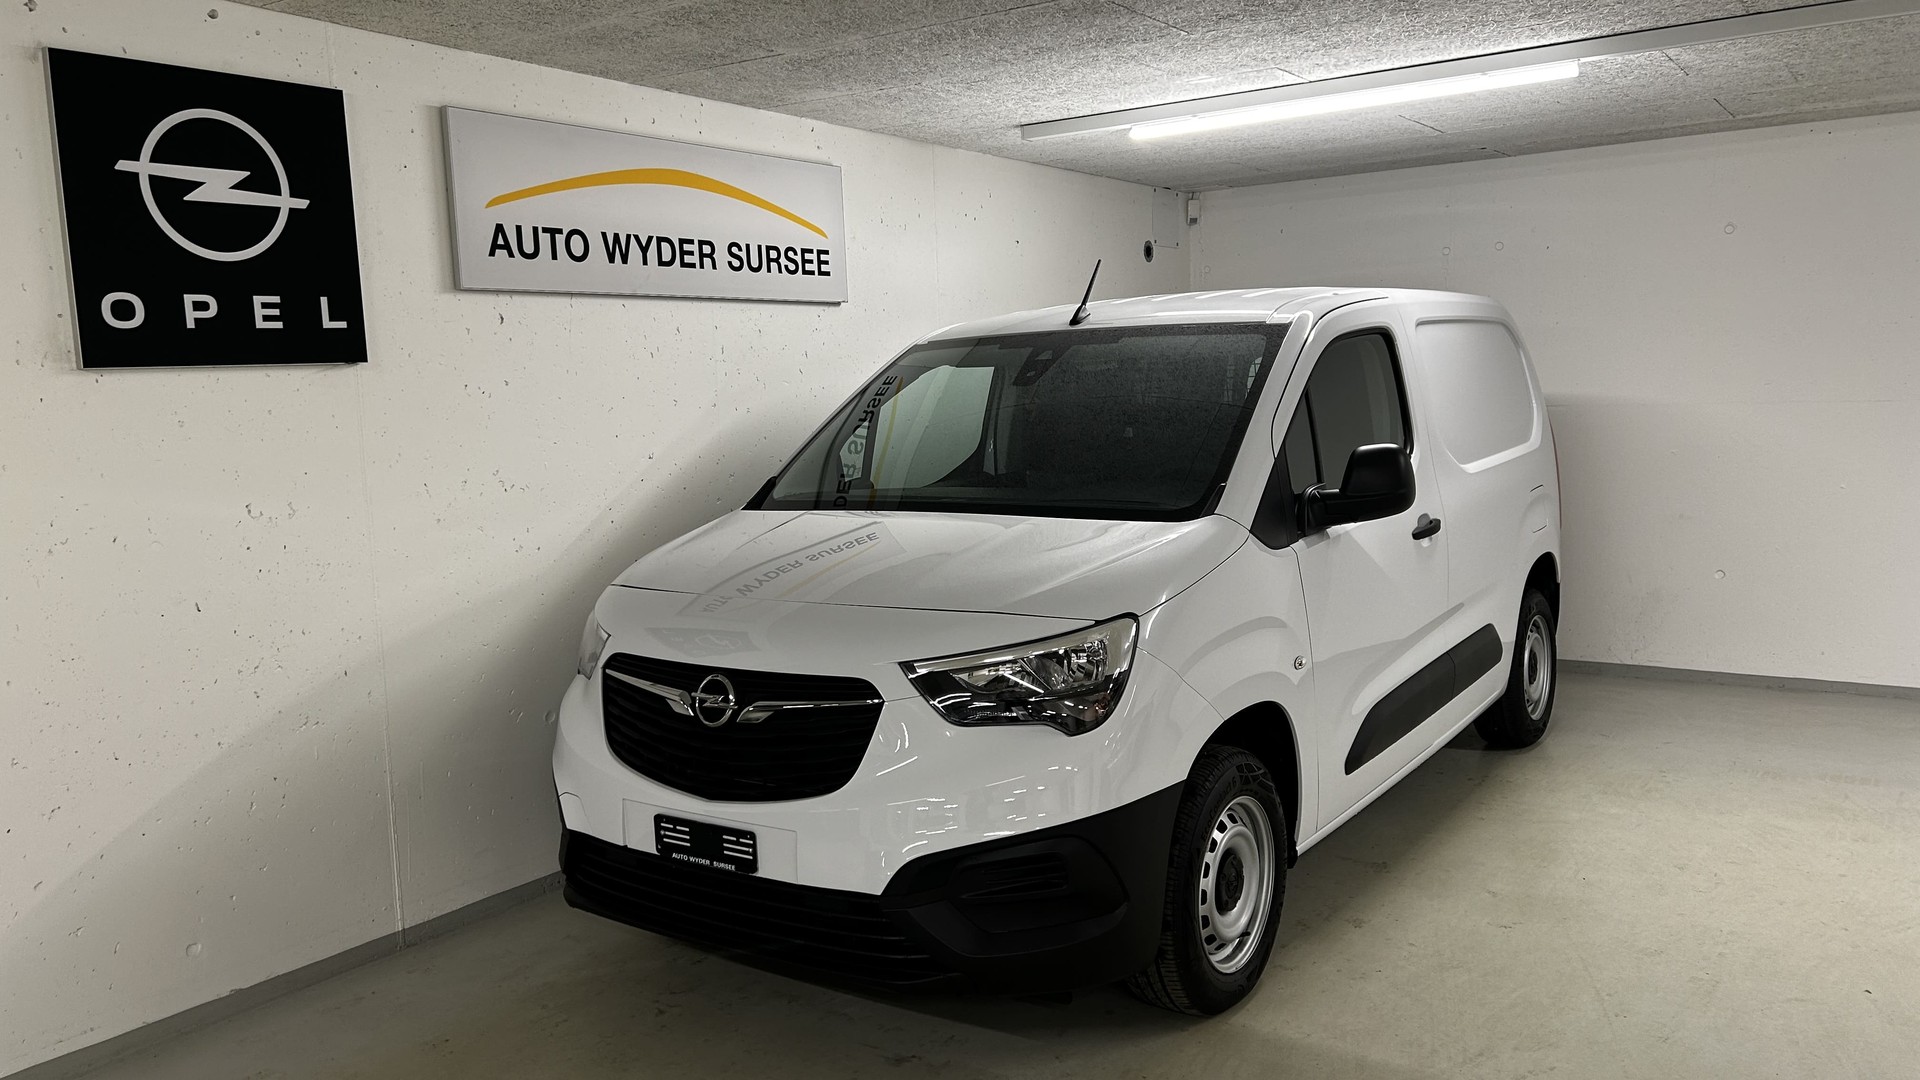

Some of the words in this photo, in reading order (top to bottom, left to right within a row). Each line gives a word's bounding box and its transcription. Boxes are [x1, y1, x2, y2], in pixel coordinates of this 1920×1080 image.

[488, 223, 589, 262] AUTO
[601, 232, 719, 270] WYDER
[727, 242, 830, 276] SURSEE
[102, 292, 347, 328] OPEL
[672, 852, 688, 861] AUTO
[689, 856, 711, 866] WYDER
